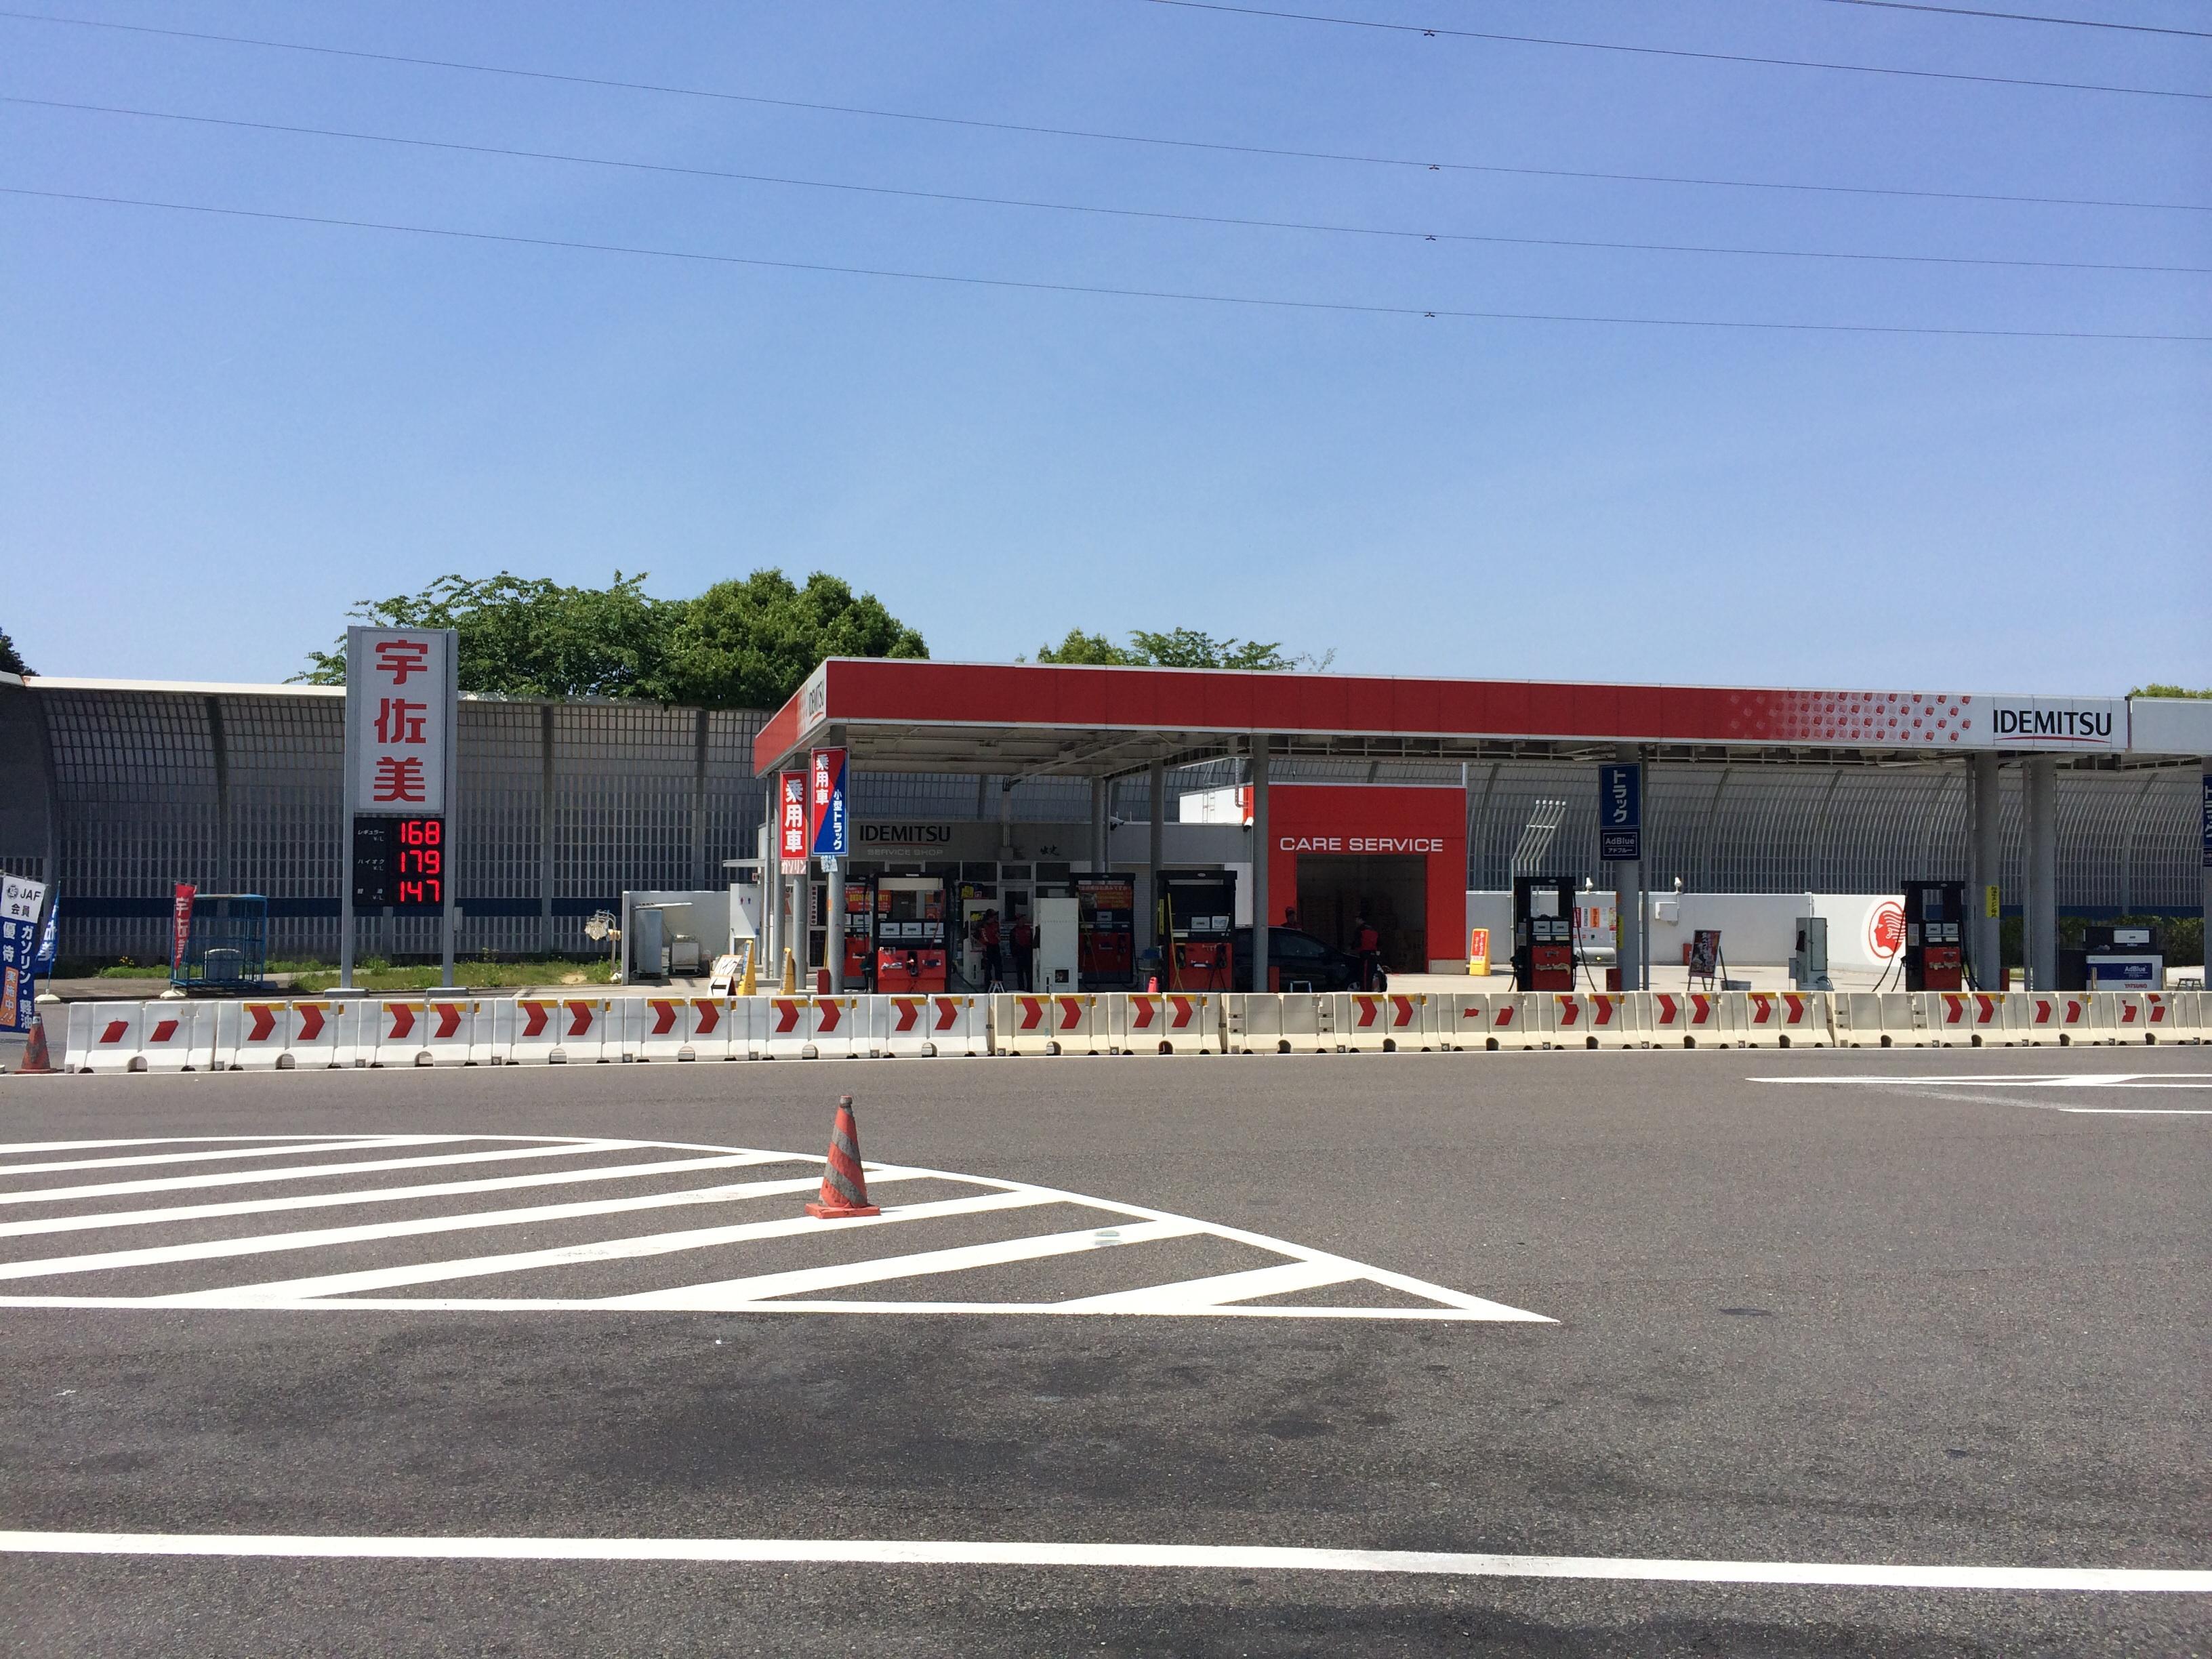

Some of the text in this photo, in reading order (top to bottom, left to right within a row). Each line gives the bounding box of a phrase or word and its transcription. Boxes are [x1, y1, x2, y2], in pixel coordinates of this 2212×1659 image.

[374, 640, 428, 802] 宇佐美
[1993, 710, 2111, 736] IDEMITSU
[815, 754, 829, 805] 乗用車
[1613, 770, 1627, 823] トラック
[785, 779, 803, 853] 乗用車
[833, 789, 842, 850] 小型トラック
[401, 821, 440, 844] 168
[860, 825, 950, 842] IDEMITSU
[1280, 838, 1443, 851] CARE SERVICE
[1605, 837, 1635, 845] AdBlue
[401, 850, 440, 874] 179
[20, 888, 41, 901] JAF
[400, 880, 440, 902] 147
[11, 903, 30, 917] 会員
[2, 921, 16, 963] 優待
